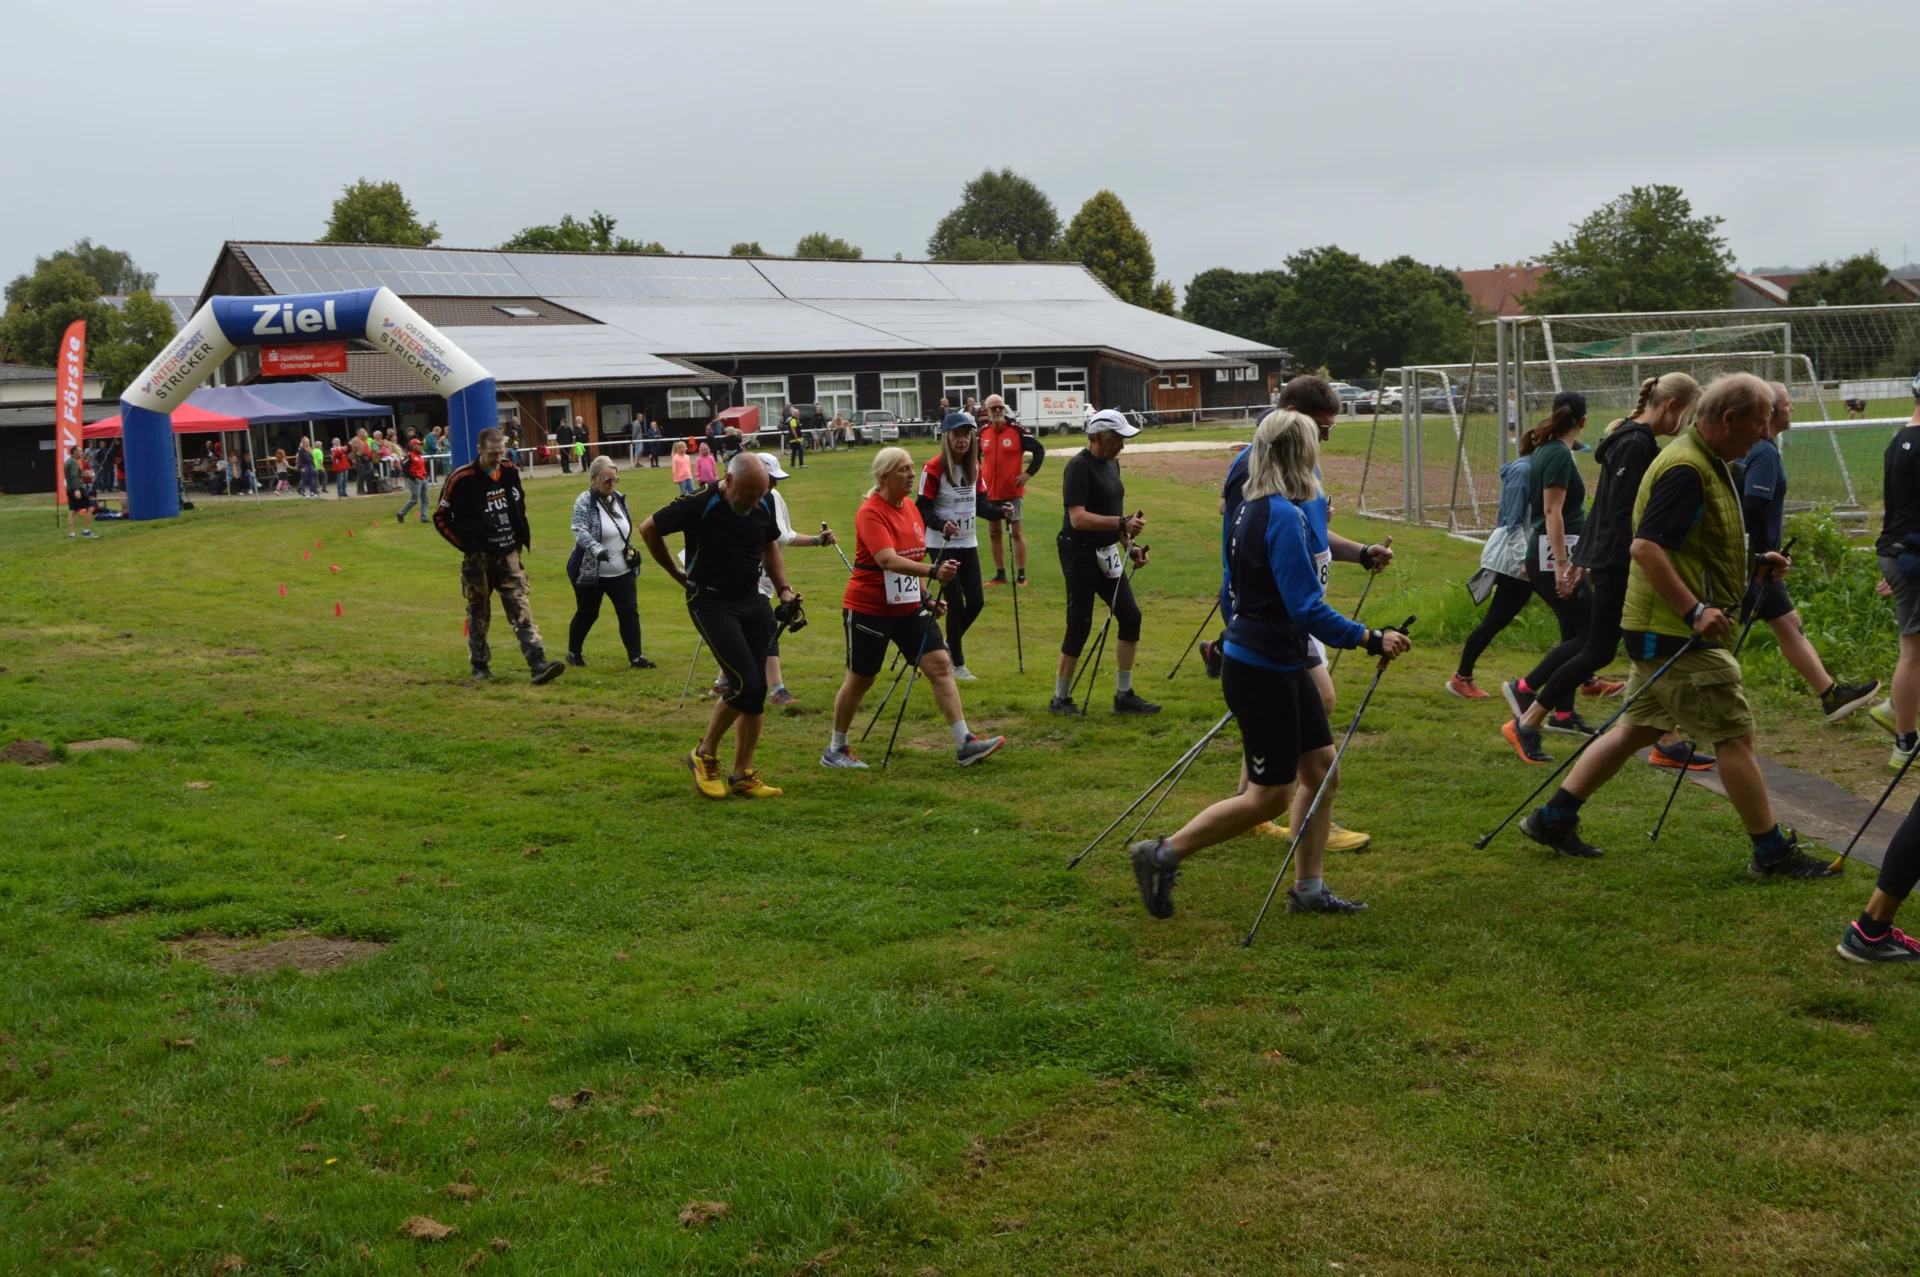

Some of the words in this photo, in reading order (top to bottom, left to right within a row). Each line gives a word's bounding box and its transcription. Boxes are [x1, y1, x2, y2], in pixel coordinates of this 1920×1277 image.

[252, 299, 337, 335] Ziel
[405, 323, 447, 357] OSTERODE
[151, 330, 205, 386] INTERSPORT
[155, 342, 214, 399] STRICKER
[280, 361, 310, 369] Osterode
[380, 332, 441, 386] STRICKER
[391, 326, 453, 377] INTERSPORT
[63, 336, 82, 424] Förste
[893, 575, 919, 594] 123
